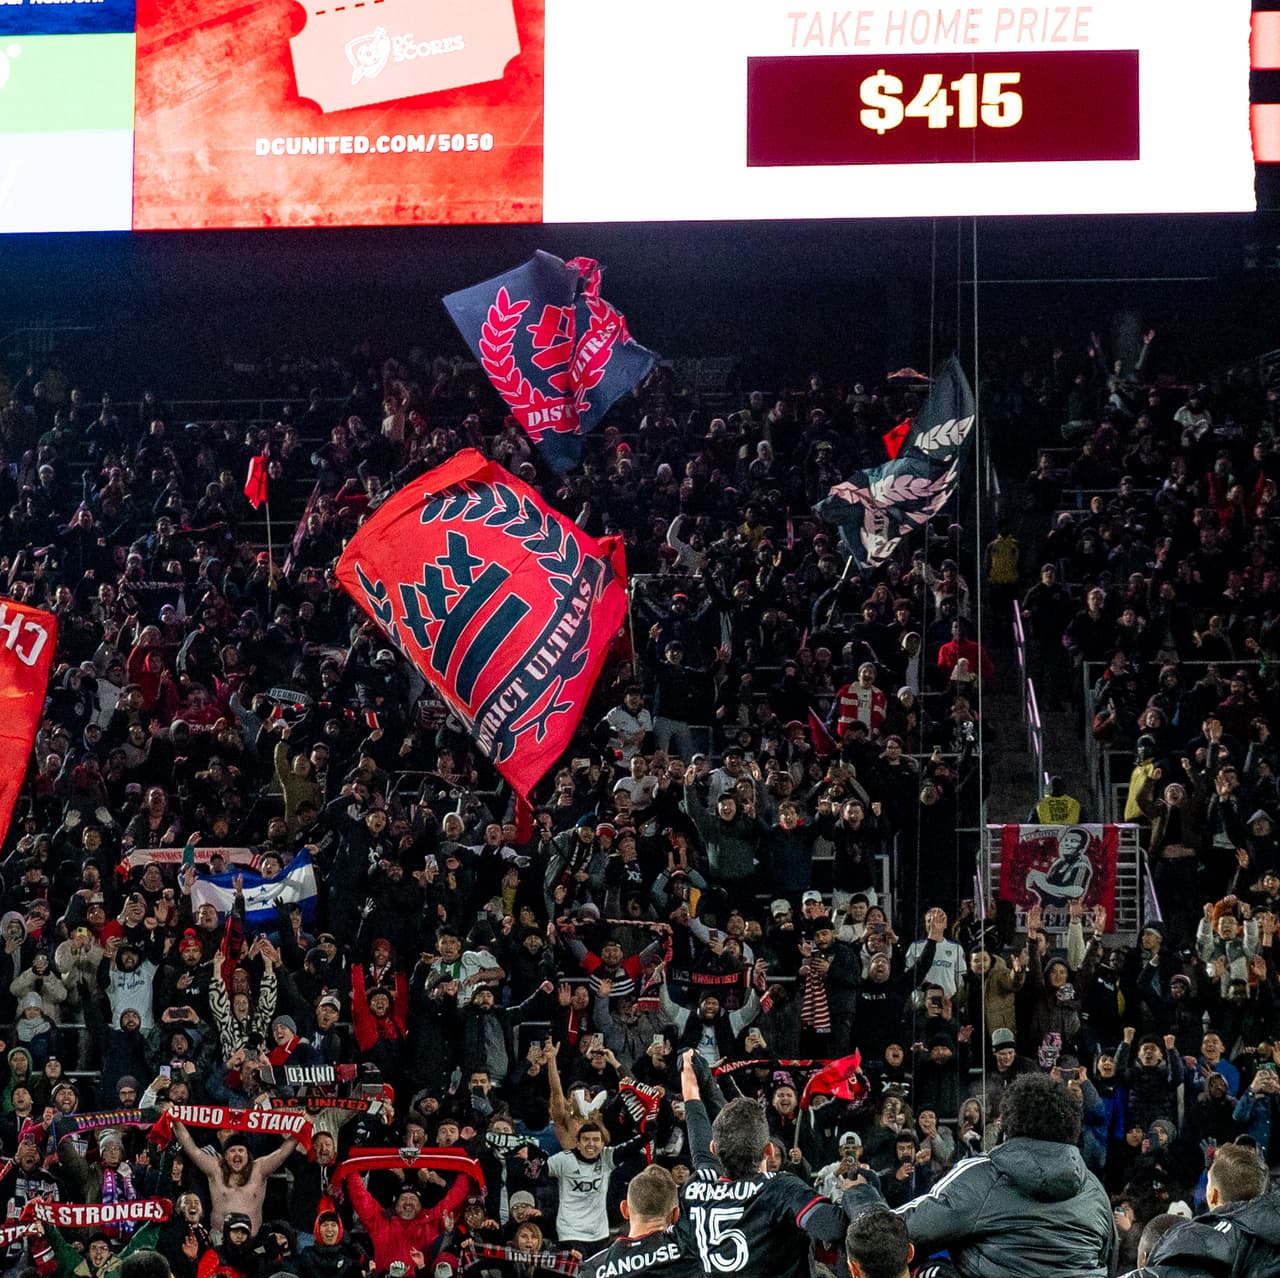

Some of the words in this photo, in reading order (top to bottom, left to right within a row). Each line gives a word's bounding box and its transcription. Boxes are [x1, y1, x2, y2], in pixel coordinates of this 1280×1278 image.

[787, 10, 874, 48] TAKE
[885, 7, 980, 47] HOME
[996, 6, 1093, 43] PRIZE
[859, 68, 1023, 135] $415
[256, 133, 494, 156] DCUNITED.COM/5050
[571, 322, 617, 383] ULTRAS
[524, 577, 593, 681] ULTRAS
[170, 1104, 223, 1126] CHICO
[307, 1099, 368, 1112] UNITED
[690, 1206, 750, 1273] 15
